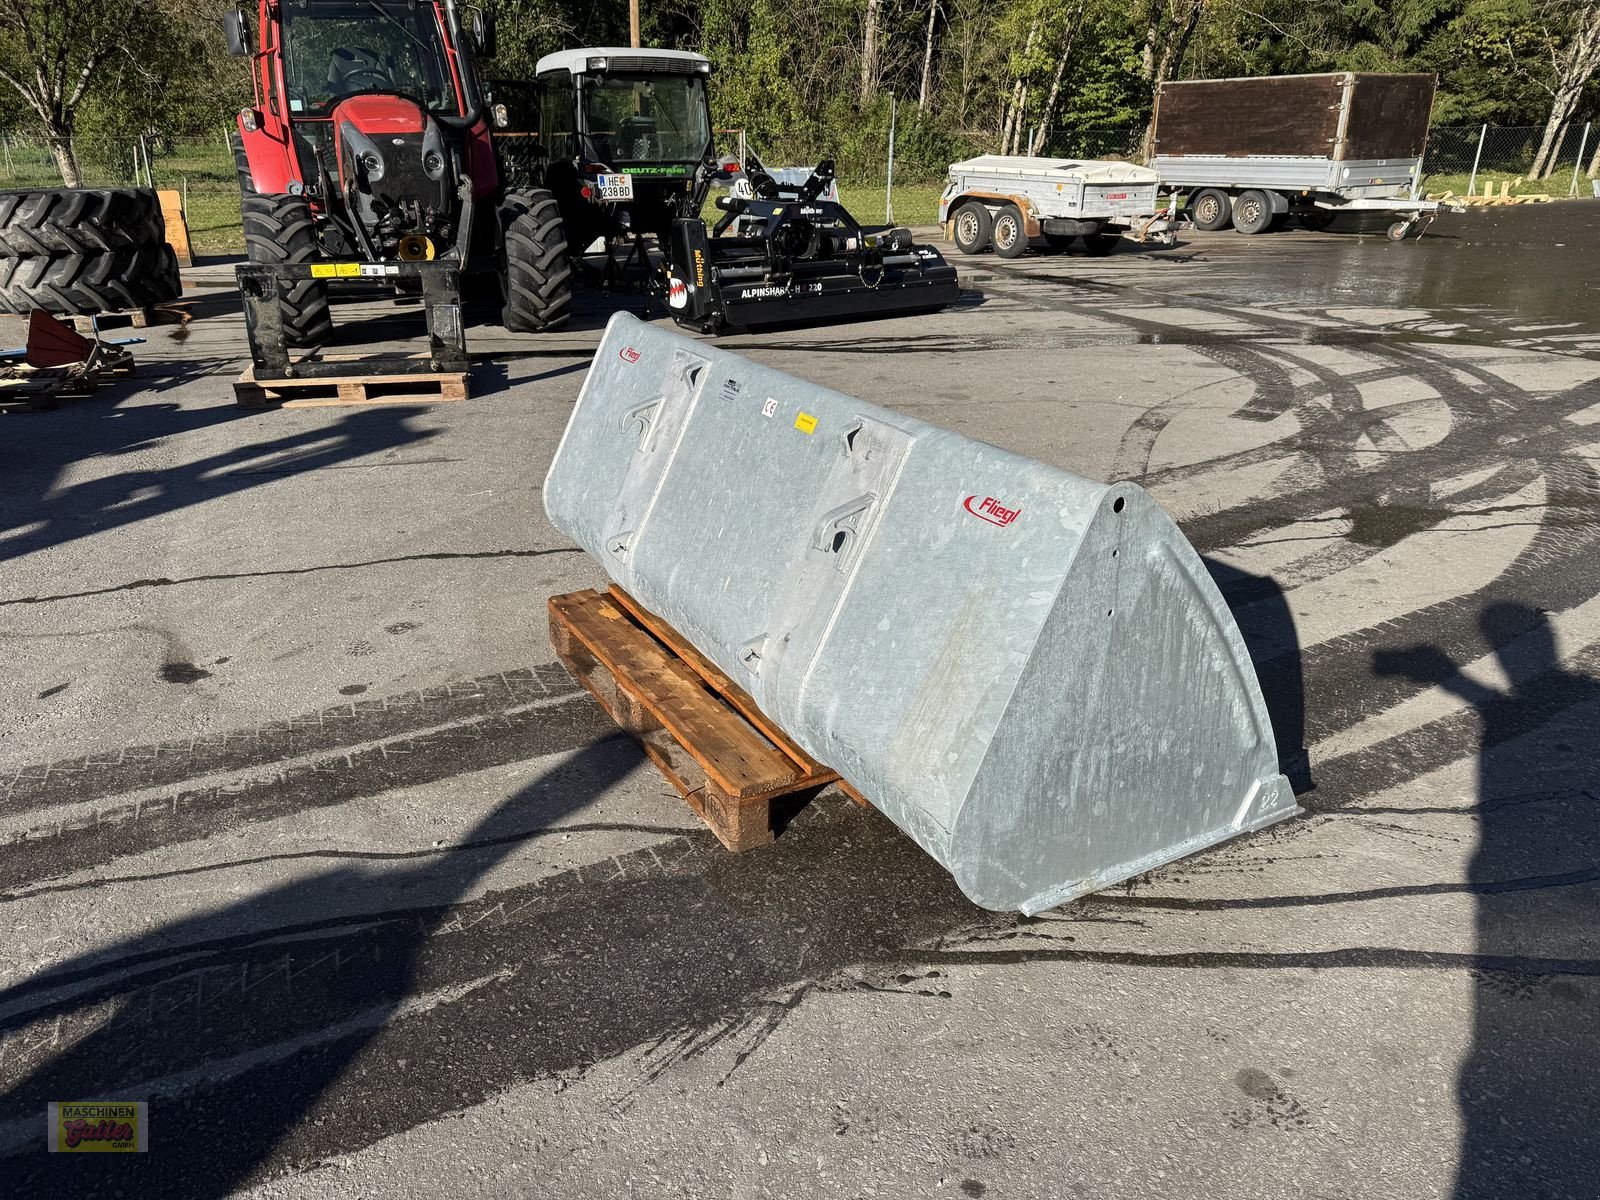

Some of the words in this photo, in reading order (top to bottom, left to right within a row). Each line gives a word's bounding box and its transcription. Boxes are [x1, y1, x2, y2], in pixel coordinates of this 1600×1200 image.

[608, 176, 619, 186] HE
[602, 187, 618, 197] 238
[619, 186, 630, 196] BD
[694, 250, 705, 287] Müthing
[808, 283, 822, 292] 220
[625, 347, 641, 362] Fliegl
[979, 496, 1022, 525] Fliegl
[1261, 791, 1279, 810] 22
